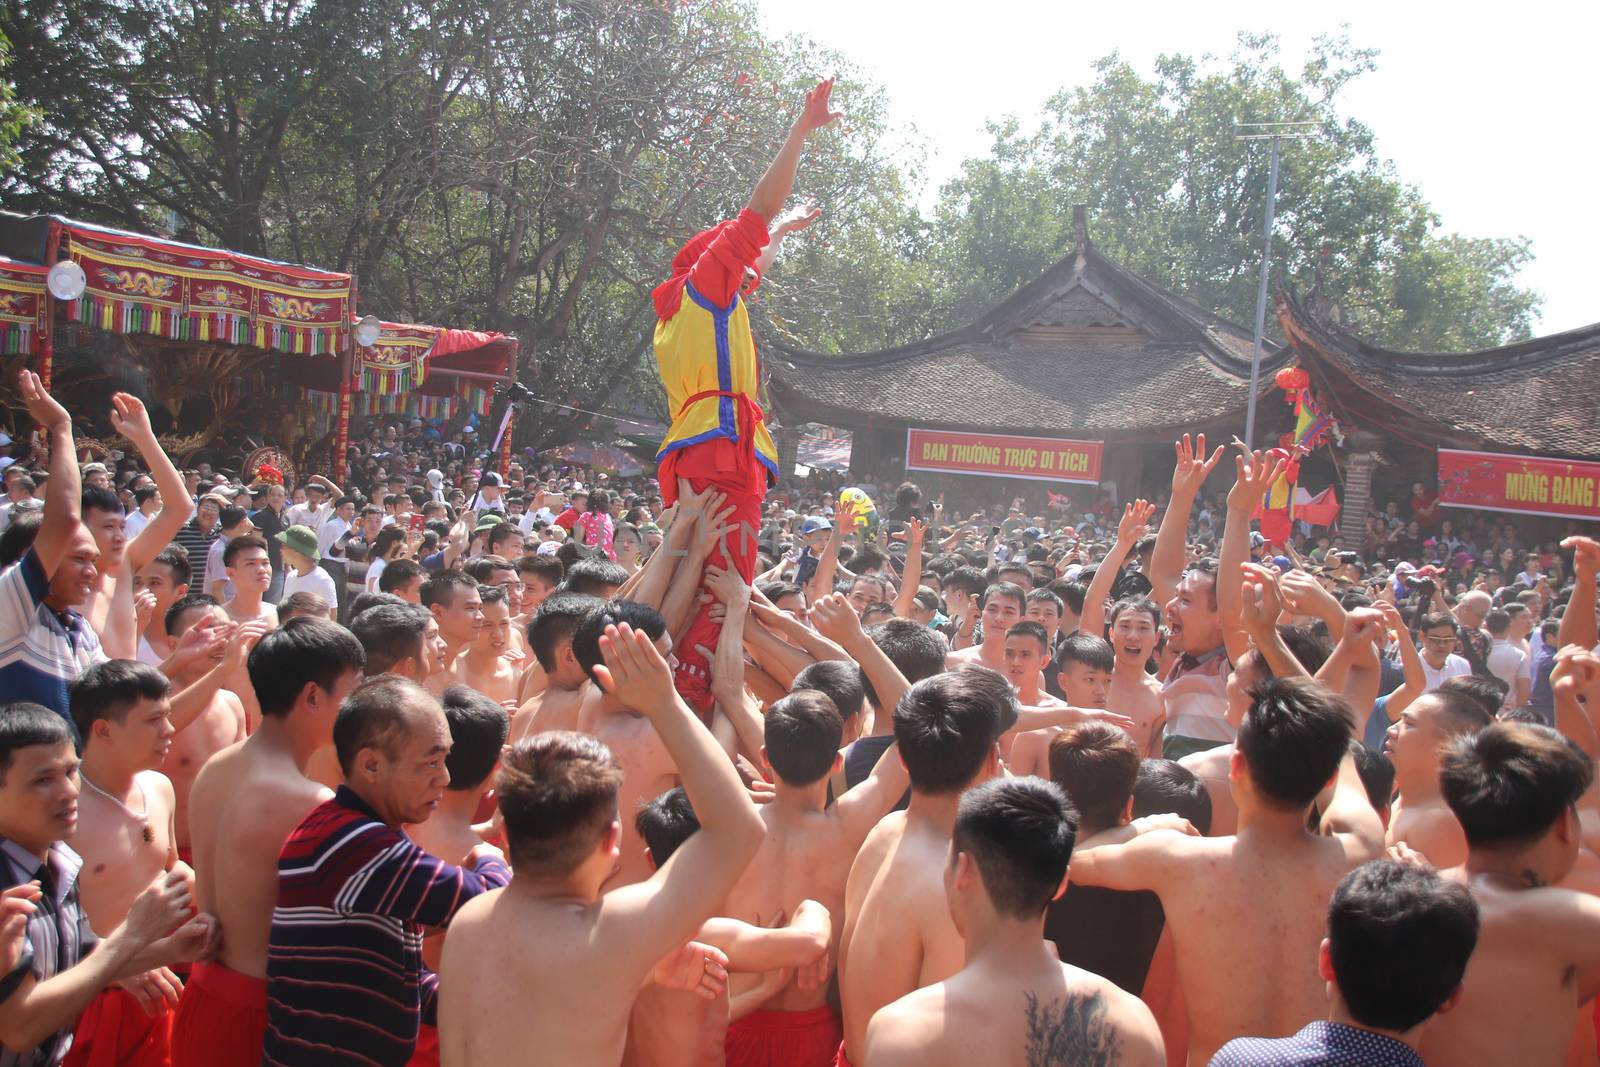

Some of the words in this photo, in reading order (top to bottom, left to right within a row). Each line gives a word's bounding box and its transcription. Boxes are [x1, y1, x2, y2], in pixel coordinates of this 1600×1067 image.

[922, 442, 948, 461] BAN
[951, 441, 1000, 465] THƯỜNG
[1004, 447, 1036, 471] TRỰC
[1040, 450, 1054, 470] DI
[1058, 448, 1088, 472] TÍCH
[1505, 461, 1549, 504] MỪNG
[1552, 464, 1594, 507] ĐẢNG
